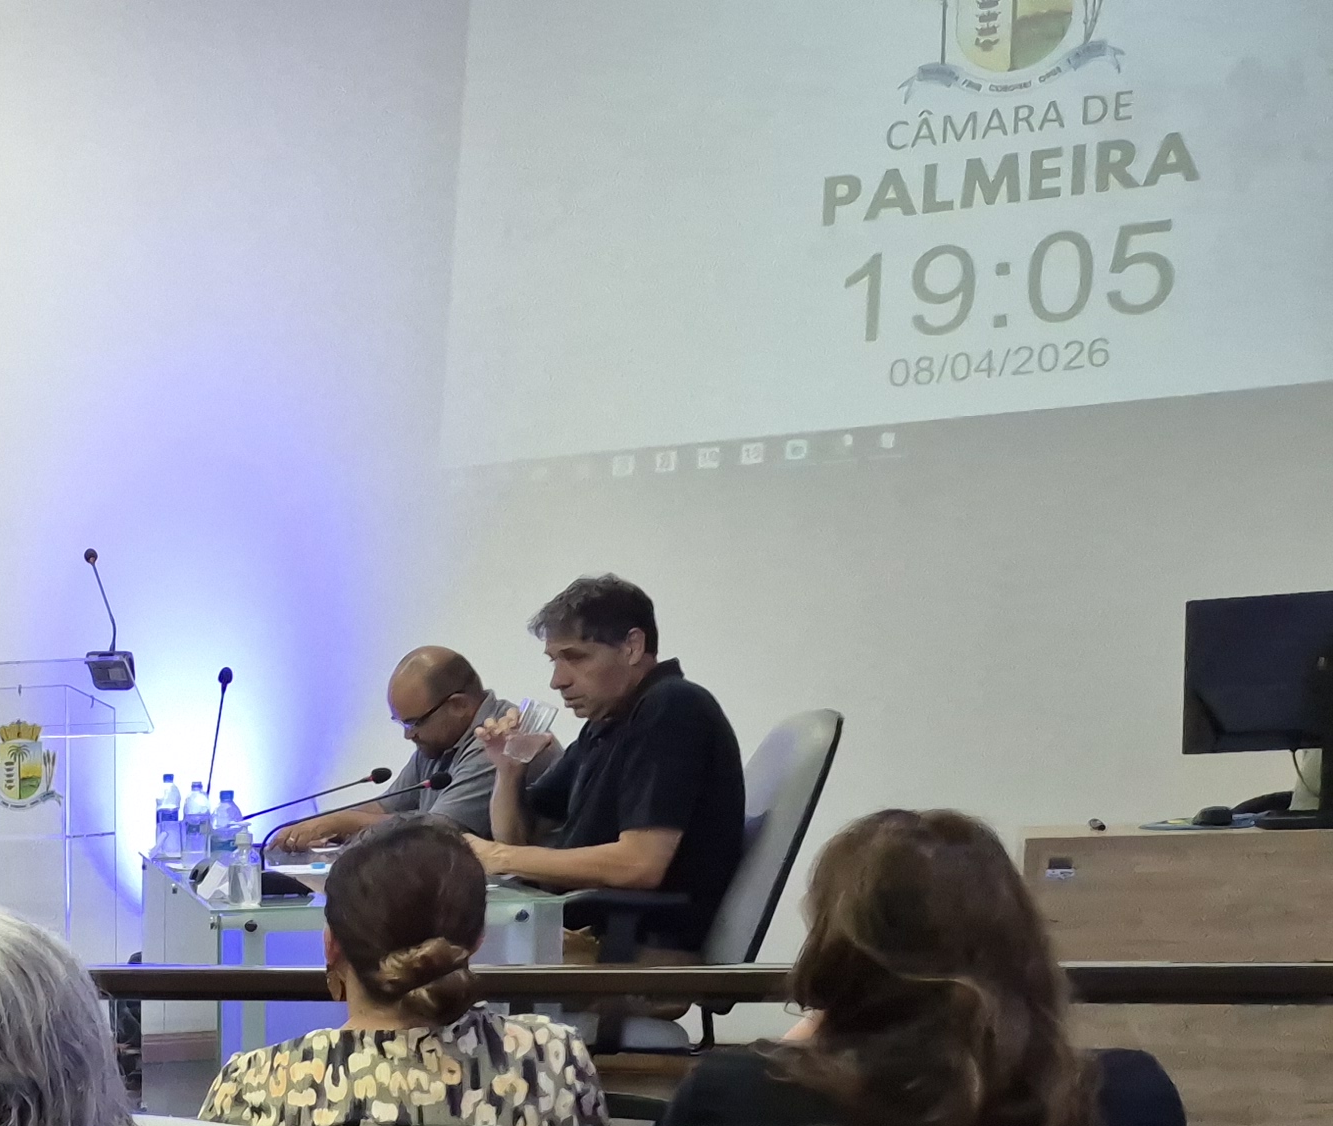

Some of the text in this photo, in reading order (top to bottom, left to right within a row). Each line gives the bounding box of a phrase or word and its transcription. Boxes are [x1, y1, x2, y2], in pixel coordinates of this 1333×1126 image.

[886, 90, 1133, 150] CÂMARA DE
[822, 132, 1201, 226] PALMEIRA
[844, 219, 1175, 342] 19:05
[889, 338, 1111, 387] 08/04/2026
